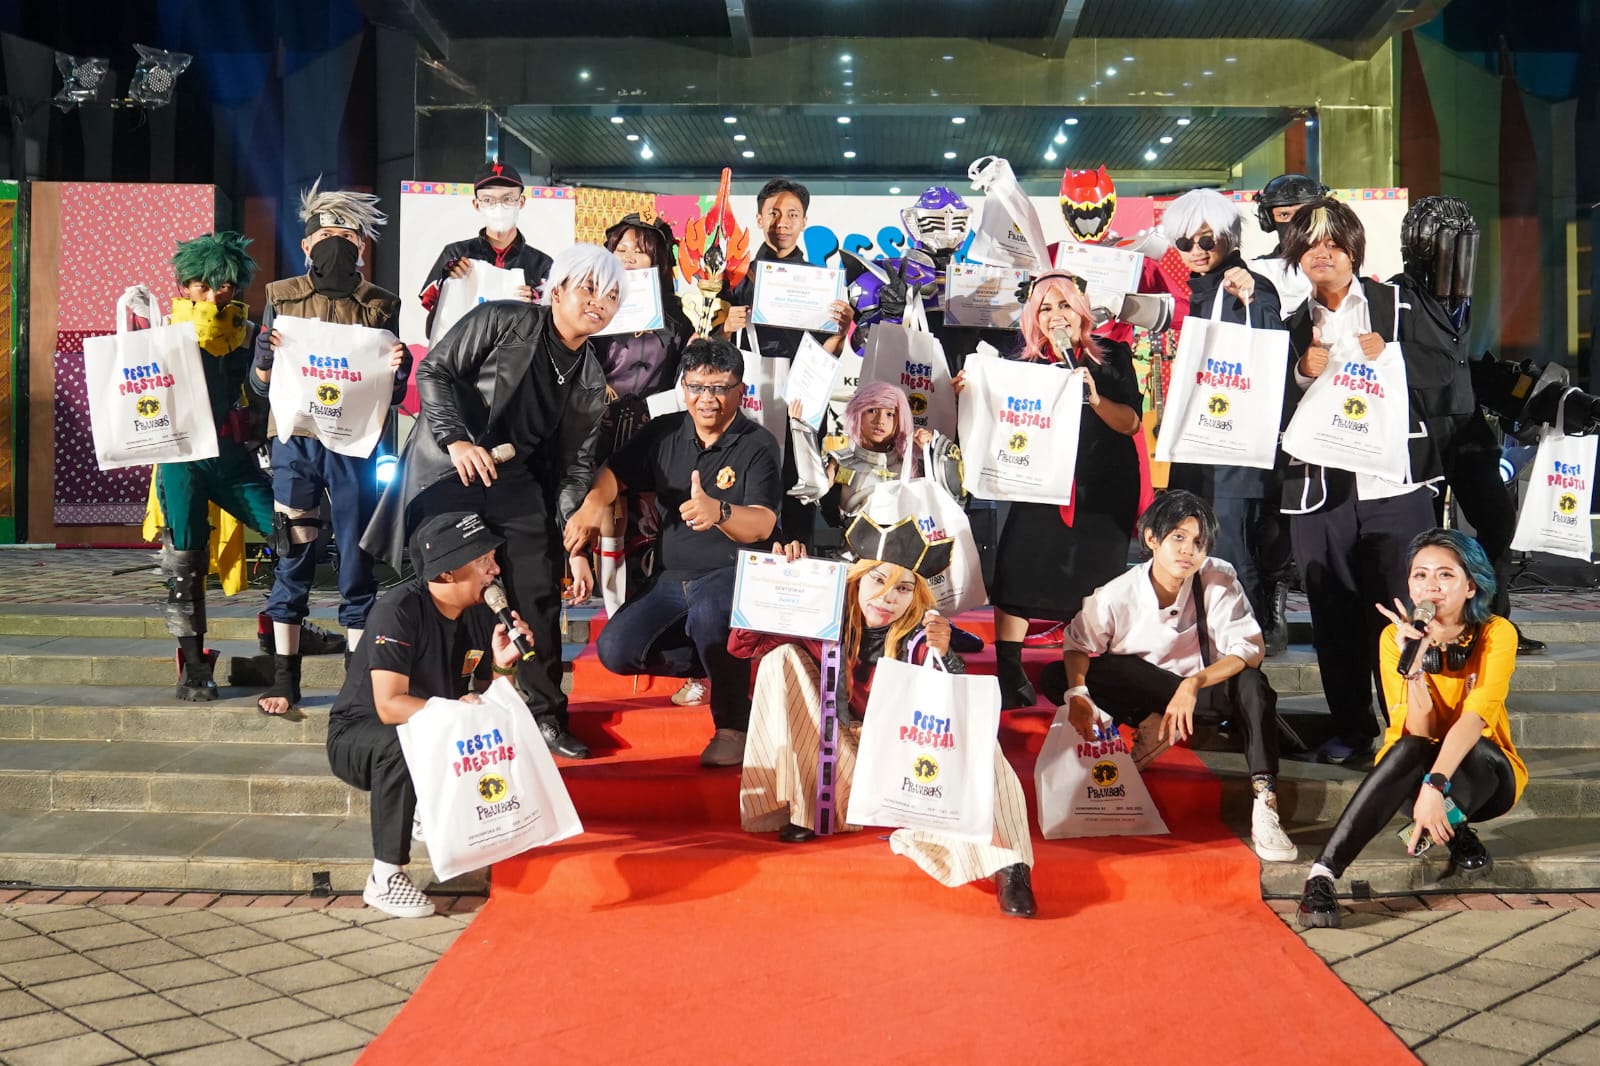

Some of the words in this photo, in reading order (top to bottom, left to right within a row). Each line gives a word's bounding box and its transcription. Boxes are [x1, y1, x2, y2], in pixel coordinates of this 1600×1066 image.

[309, 354, 349, 369] PESTA
[905, 360, 932, 376] PEST
[1207, 358, 1242, 376] PESTA
[122, 362, 160, 380] PESTA
[301, 366, 362, 382] PRESTASI
[119, 374, 175, 396] PRESTASI
[1196, 371, 1250, 390] PRESTASI
[1007, 396, 1042, 412] PESTA
[999, 410, 1051, 429] PRESTASI
[456, 728, 503, 756] PESTA
